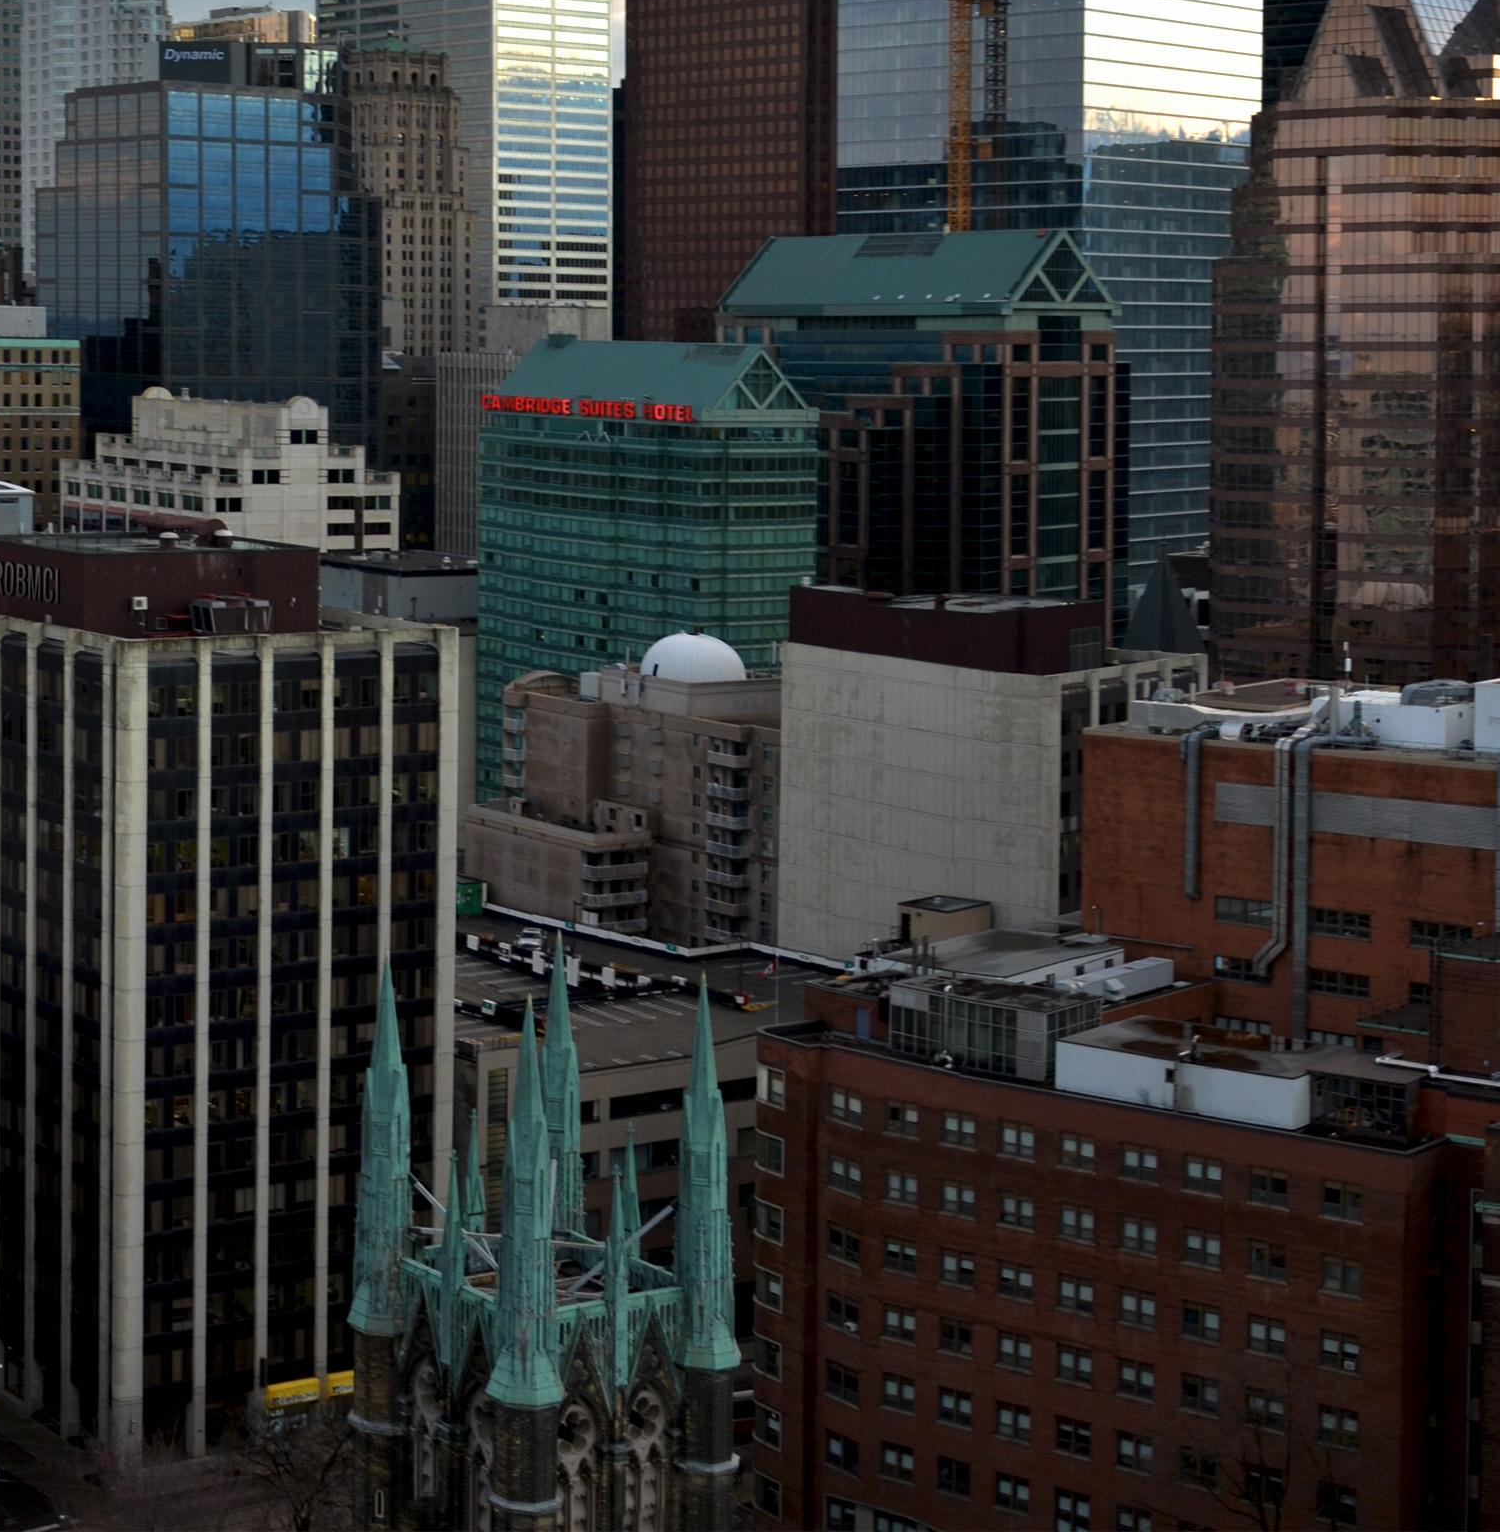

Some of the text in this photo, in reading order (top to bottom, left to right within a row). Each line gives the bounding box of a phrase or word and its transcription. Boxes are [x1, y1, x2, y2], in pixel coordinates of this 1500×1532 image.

[164, 48, 226, 63] Dynamic
[481, 394, 694, 423] CAMBRIDGE SUITES HOTEL
